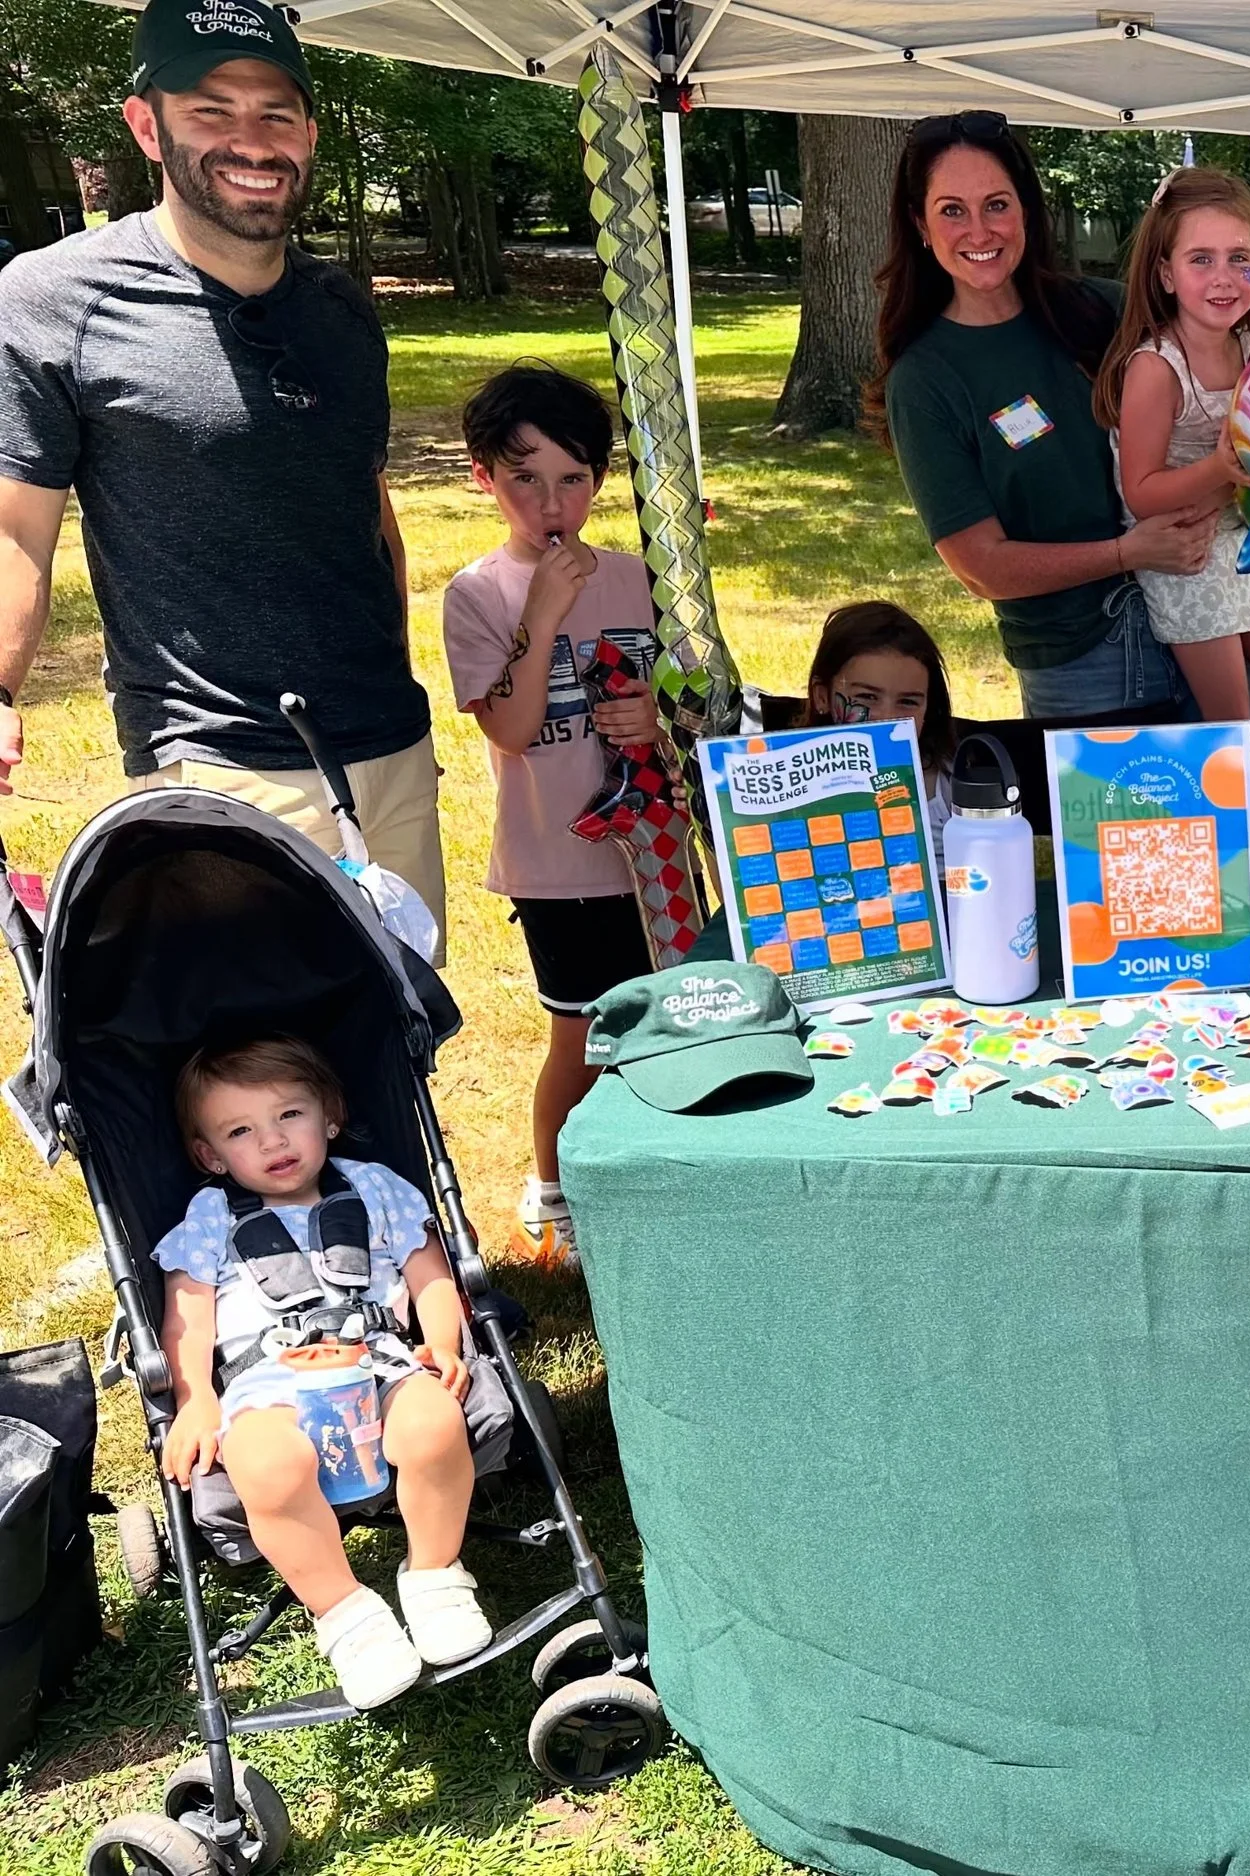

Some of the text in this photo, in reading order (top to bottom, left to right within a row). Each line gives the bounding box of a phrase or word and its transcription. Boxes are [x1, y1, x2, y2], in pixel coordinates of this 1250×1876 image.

[185, 9, 261, 27] Balance
[194, 21, 274, 43] Project
[732, 741, 870, 775] MORE SUMMER
[733, 759, 873, 795] LESS BUMMER
[873, 771, 897, 785] $500
[1105, 766, 1128, 804] SCOTCH
[740, 785, 809, 805] CHALLENGE
[1128, 783, 1172, 794] Balance
[1132, 792, 1179, 805] Project
[1118, 953, 1211, 976] JOIN US!
[663, 990, 741, 1014] Balance
[674, 1000, 760, 1027] Project
